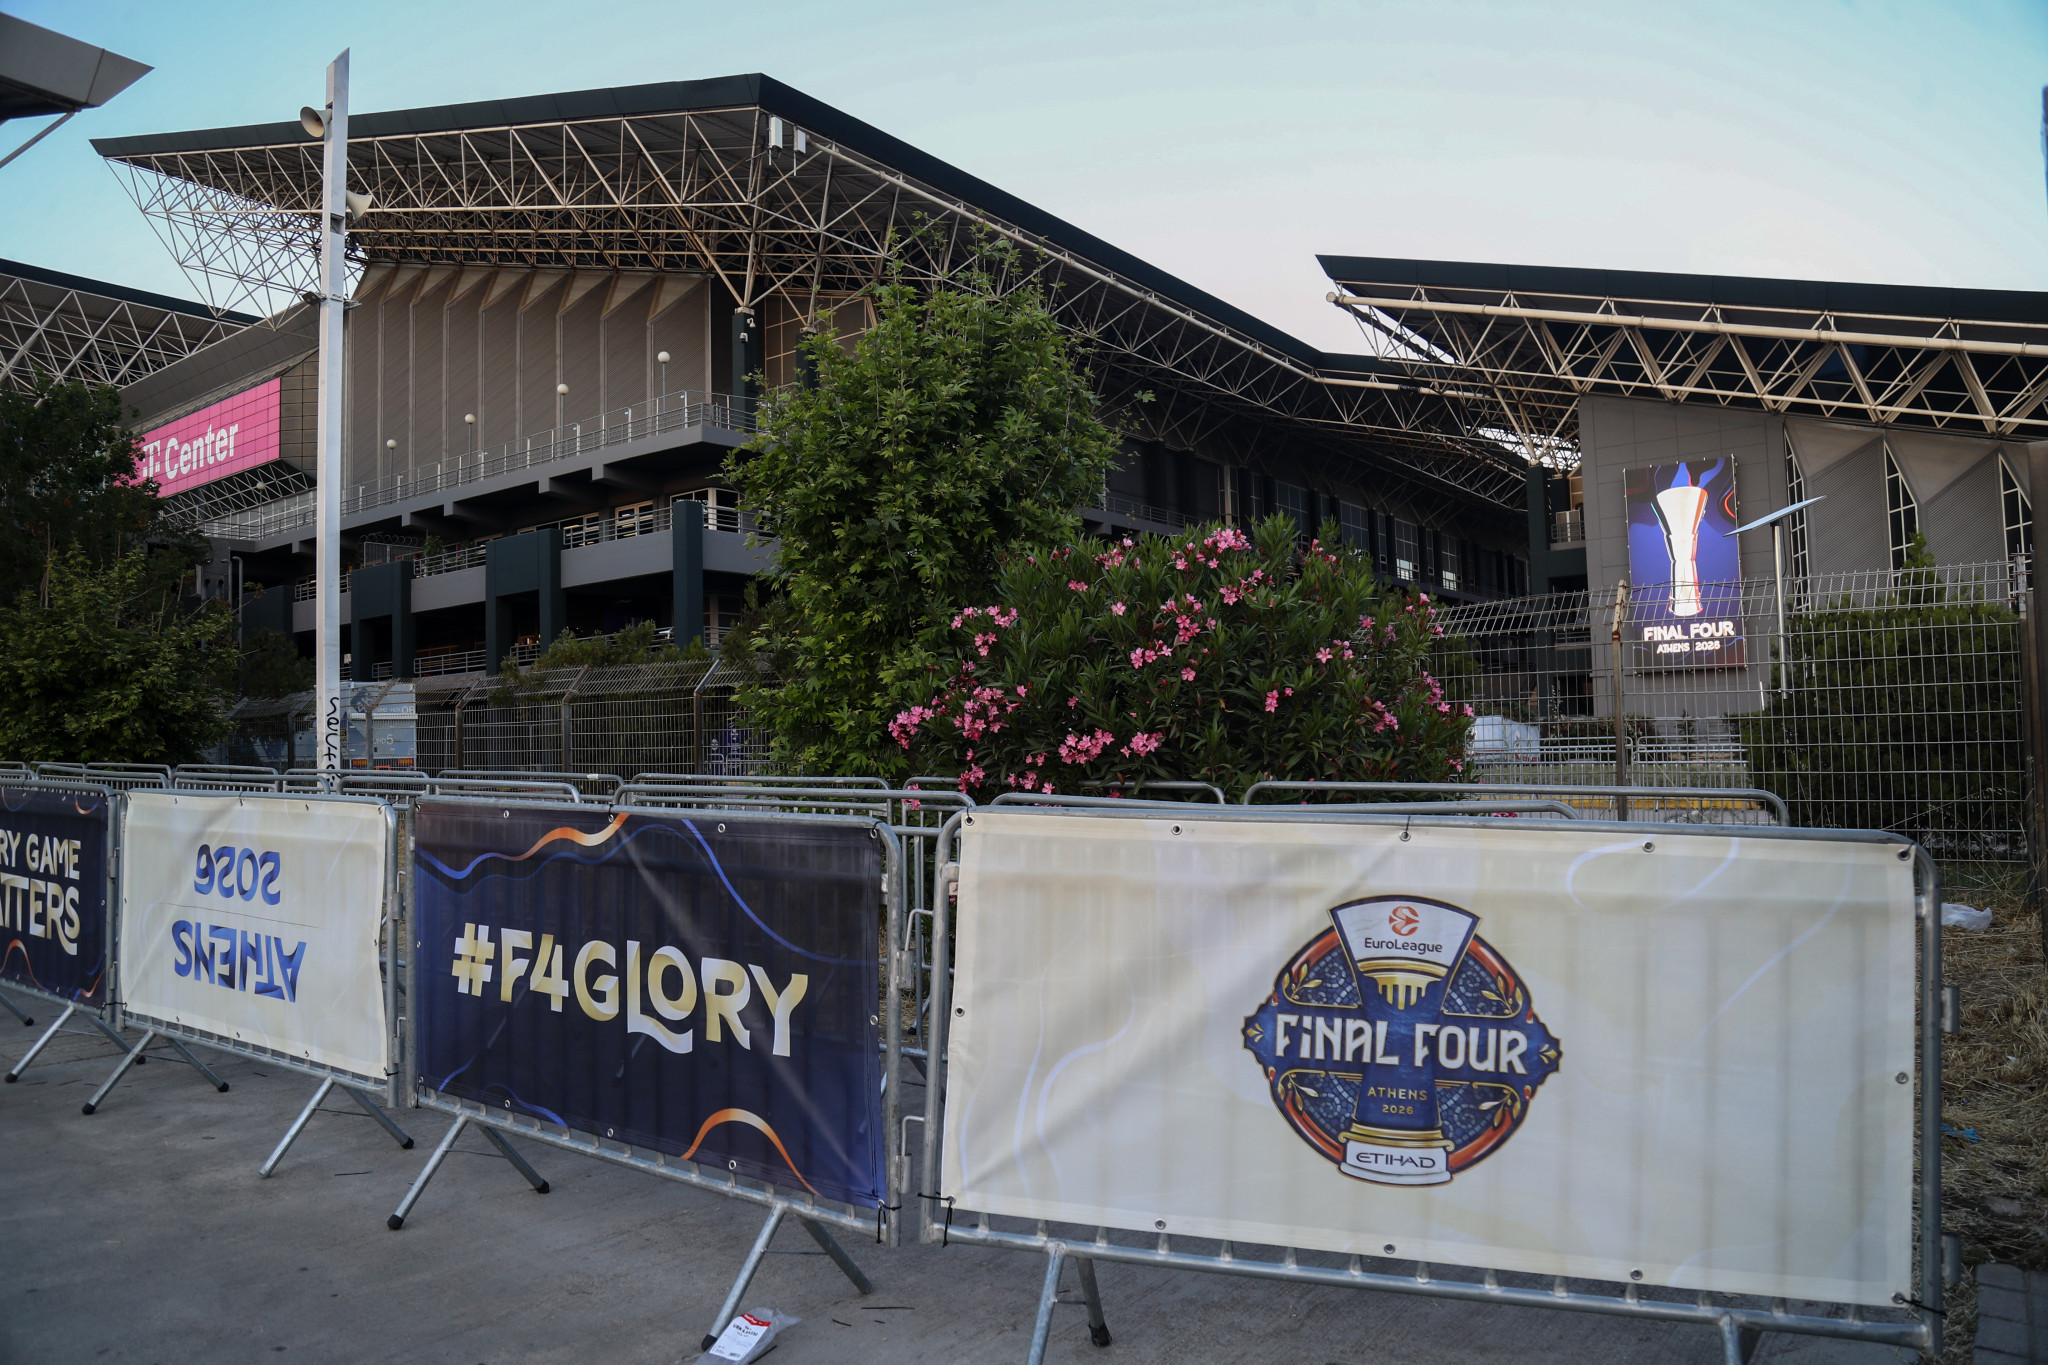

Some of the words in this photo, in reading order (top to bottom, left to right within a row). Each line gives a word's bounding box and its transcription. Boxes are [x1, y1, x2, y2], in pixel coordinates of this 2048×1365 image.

[165, 424, 239, 480] Center
[1643, 624, 1688, 641] FINAL
[1690, 621, 1735, 639] FOUR
[1657, 642, 1690, 654] ATHENS
[26, 833, 81, 880] GAME
[194, 843, 281, 905] 2026
[0, 872, 80, 956] TTERS
[172, 920, 307, 1003] ATHENS
[1364, 937, 1443, 955] EuroLeague
[451, 922, 809, 1057] #F4GLORY
[1275, 1013, 1399, 1066] FINAL
[1414, 1022, 1528, 1075] FOUR
[1367, 1086, 1428, 1101] ATHENS
[1382, 1104, 1414, 1115] 2026
[1356, 1152, 1436, 1169] ETIHAD
